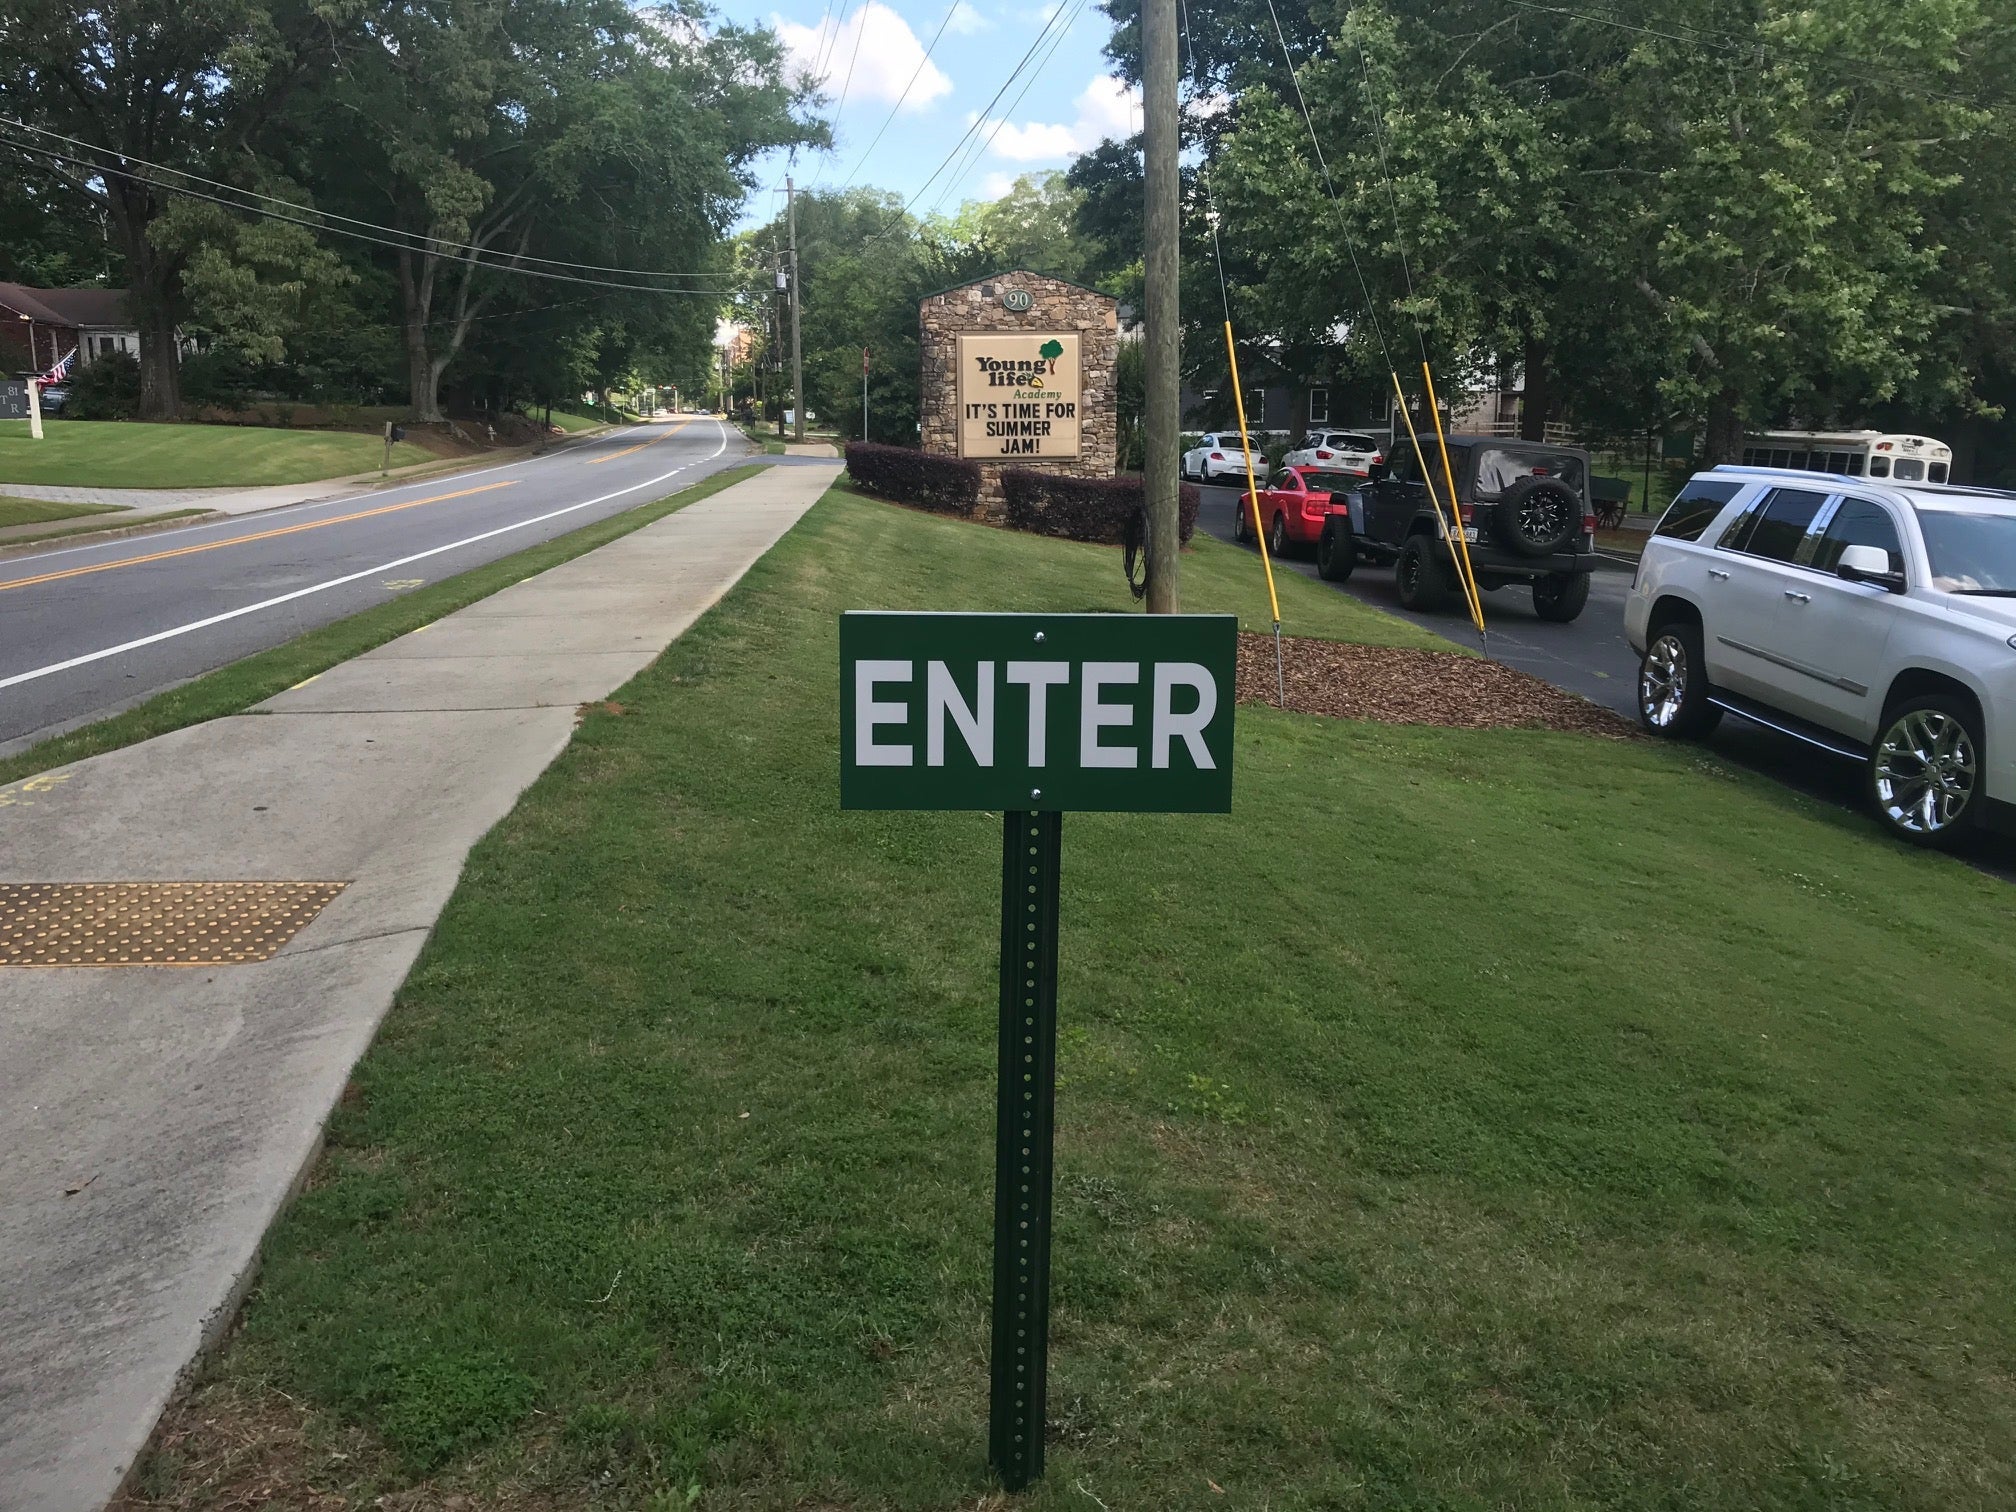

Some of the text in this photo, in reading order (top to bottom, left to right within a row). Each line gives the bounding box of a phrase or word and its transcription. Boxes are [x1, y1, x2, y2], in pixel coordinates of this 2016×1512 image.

[1009, 292, 1028, 307] 90
[975, 357, 1046, 374] Young
[988, 371, 1027, 387] life
[7, 385, 18, 396] 81
[1013, 389, 1062, 400] Academy
[966, 403, 1075, 419] IT'S TIME FOR
[986, 421, 1051, 437] SUMMER
[1001, 439, 1040, 454] JAM!
[855, 660, 1217, 769] ENTER
